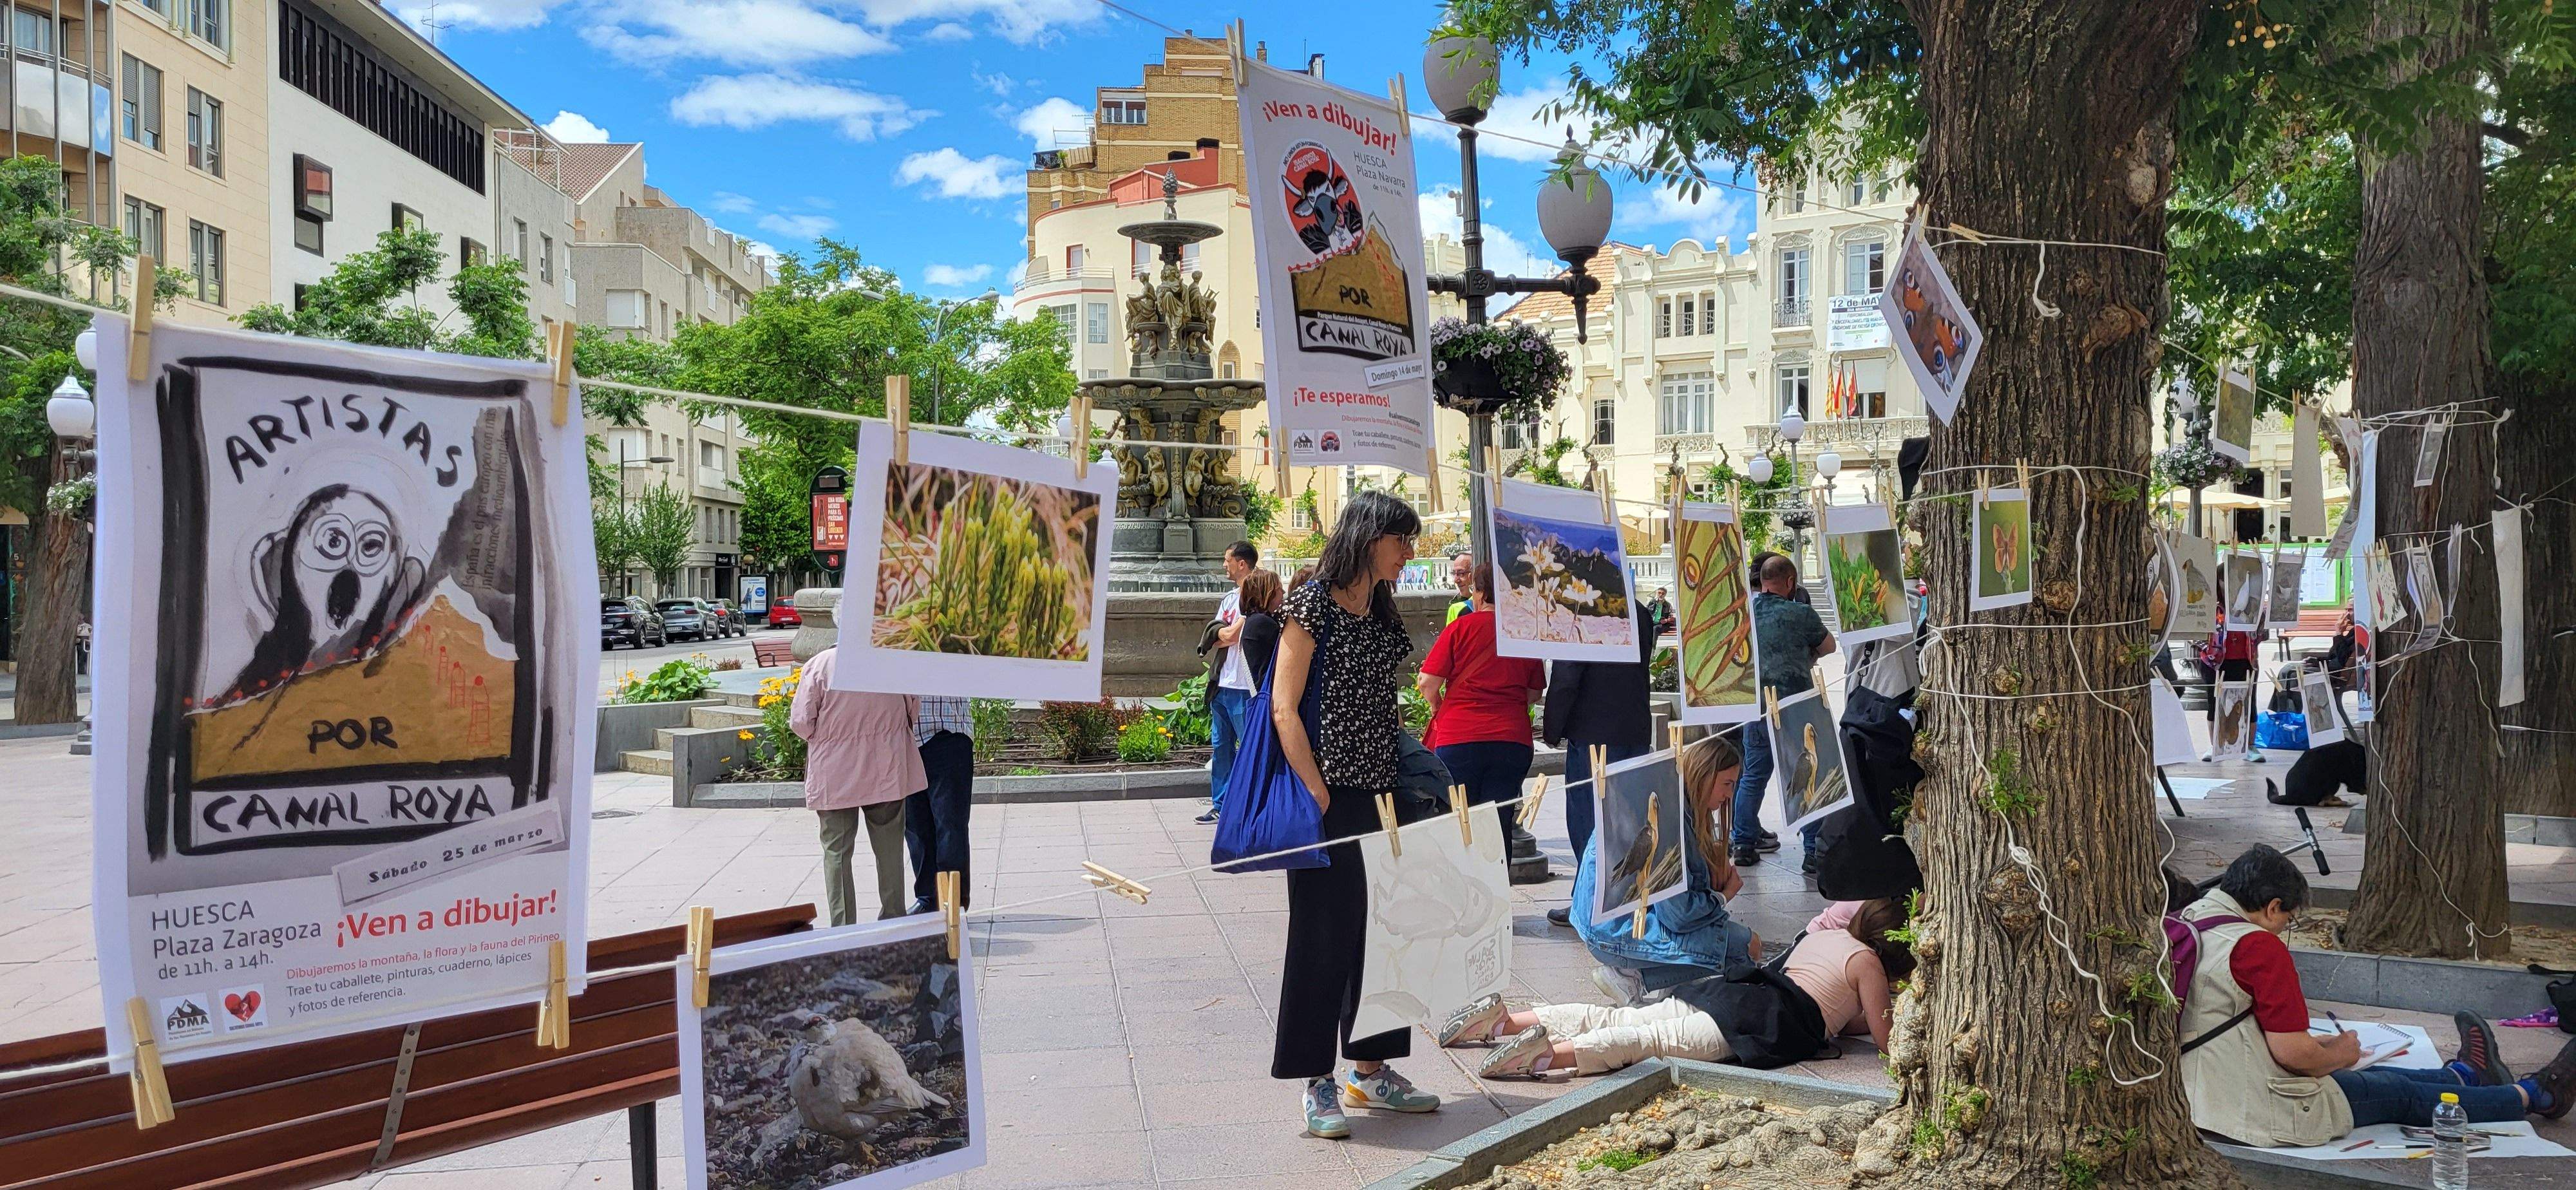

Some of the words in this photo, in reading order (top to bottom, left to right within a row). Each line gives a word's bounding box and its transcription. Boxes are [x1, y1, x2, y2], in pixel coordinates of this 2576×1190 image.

[1262, 100, 1303, 122] ¡Ven
[1305, 104, 1319, 120] a
[1322, 101, 1397, 156] dibujar!
[1353, 150, 1388, 169] HUESCA
[1356, 165, 1377, 180] Plaza
[1378, 170, 1406, 188] Navarra
[1339, 285, 1373, 308] POR
[1832, 299, 1844, 308] 12
[1846, 299, 1858, 307] de
[1861, 297, 1881, 306] MAY
[1305, 321, 1370, 350] CANAL
[1372, 329, 1407, 357] ROYA
[1371, 369, 1398, 382] Domingo
[1398, 366, 1405, 376] 14
[1405, 365, 1411, 373] de
[1411, 364, 1423, 374] mayo
[1294, 387, 1316, 406] ¡Te
[1320, 390, 1391, 408] esperamos!
[225, 393, 462, 487] ARTISTAS
[484, 433, 494, 450] con
[471, 520, 485, 530] el
[473, 532, 483, 545] es
[462, 547, 480, 587] España
[479, 525, 500, 590] infracciones
[307, 716, 398, 754] POR
[203, 791, 371, 833] CANAL
[386, 783, 496, 824] ROYA
[368, 860, 428, 883] Sábado
[442, 847, 464, 862] 25
[471, 842, 488, 856] de
[494, 827, 544, 848] marzo
[151, 900, 255, 931] HUESCA
[337, 911, 407, 949] ¡Ven
[417, 910, 434, 931] a
[443, 888, 557, 927] dibujar!
[153, 935, 214, 959] Plaza
[223, 922, 322, 949] Zaragoza
[286, 961, 356, 980] Dibujaremos
[358, 958, 368, 969] la
[370, 952, 421, 967] montaña,
[424, 949, 433, 959] la
[435, 947, 458, 958] flora
[460, 945, 467, 956] y
[469, 943, 478, 953] la
[480, 940, 509, 952] fauna
[511, 937, 526, 947] del
[528, 932, 560, 945] Pirineo
[158, 963, 178, 980] de
[184, 958, 218, 977] 11h.
[224, 958, 234, 970] a
[238, 950, 274, 969] 14h.
[286, 985, 312, 997] Trae
[315, 982, 327, 993] tu
[330, 974, 384, 990] caballete,
[387, 965, 435, 984] pinturas,
[438, 958, 493, 974] cuaderno,
[496, 952, 532, 966] lápices
[289, 1005, 296, 1018] y
[298, 1001, 328, 1014] fotos
[330, 996, 346, 1008] de
[348, 986, 406, 1005] referencia.
[167, 1015, 210, 1031] PDMA
